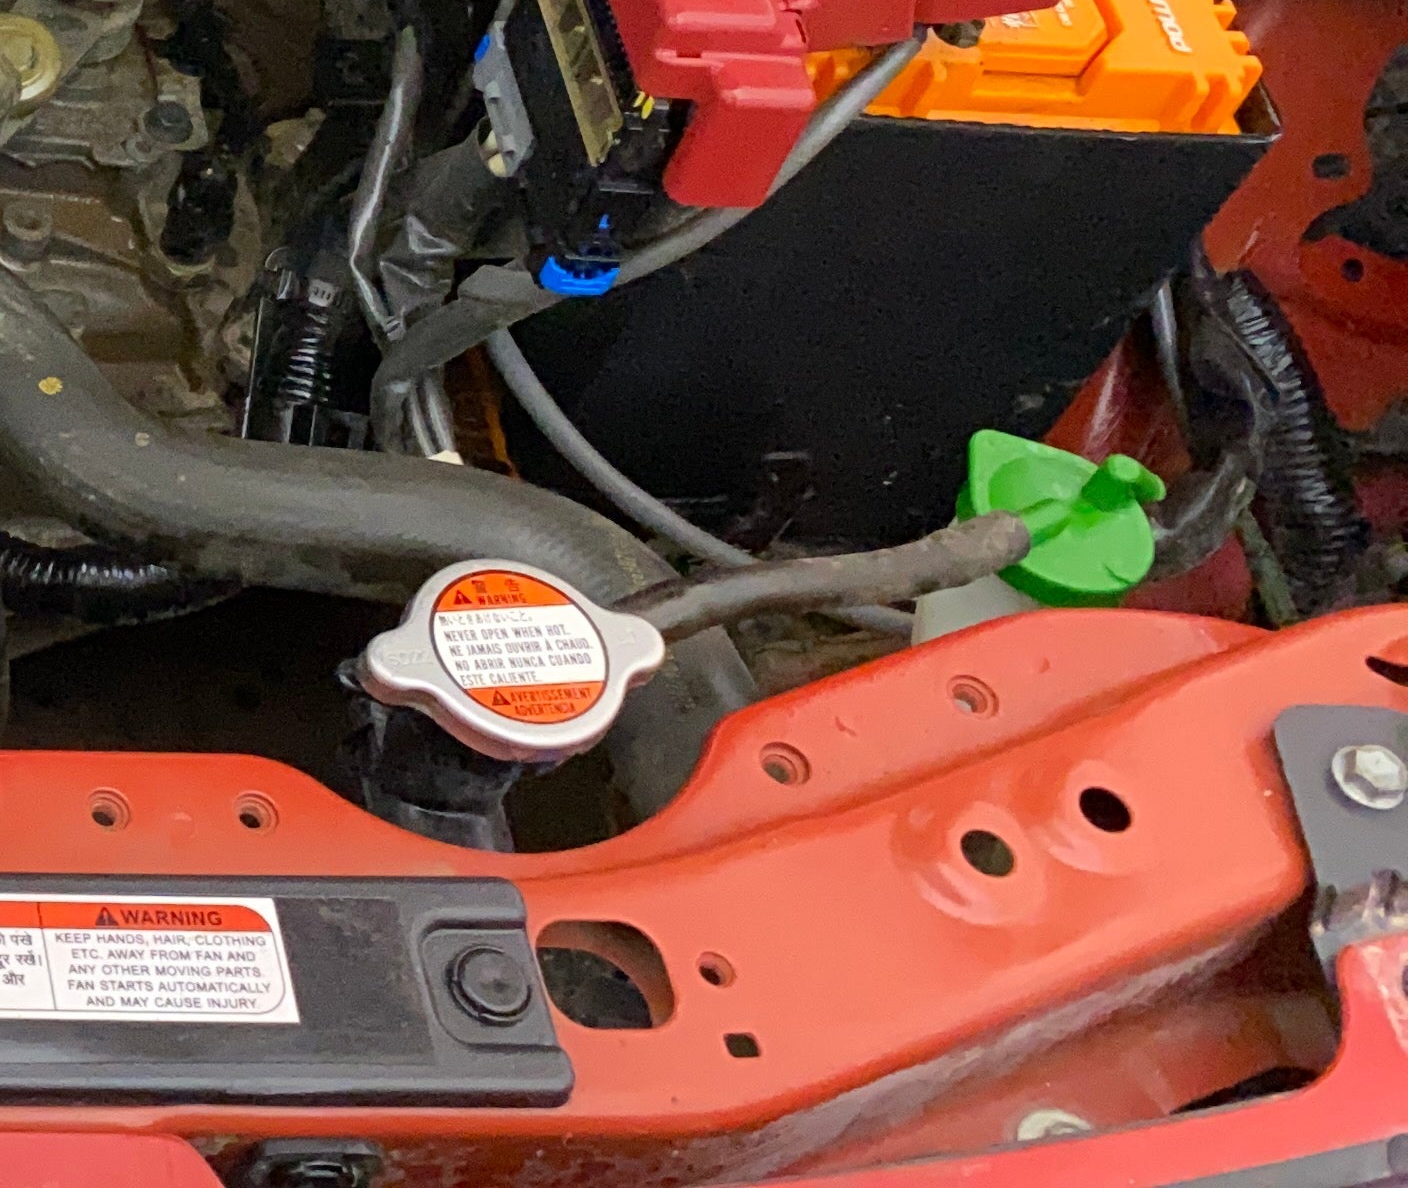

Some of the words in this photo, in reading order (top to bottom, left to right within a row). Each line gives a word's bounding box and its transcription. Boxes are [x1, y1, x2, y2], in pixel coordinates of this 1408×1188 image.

[478, 593, 528, 605] WARNING
[444, 629, 478, 642] NEVER
[481, 627, 508, 640] OPEN
[511, 625, 543, 638] WHEN
[449, 645, 464, 657] NE
[466, 643, 502, 656] JAMAIS
[505, 641, 542, 654] OUVRIR
[455, 660, 470, 671] NO
[475, 657, 506, 670] ABRIR
[508, 655, 546, 669] NUNCA
[548, 653, 592, 667] CUANDO
[460, 674, 486, 687] ESTE
[510, 687, 592, 703] AVERTISSEMENT
[120, 910, 223, 927] WARNING
[10, 930, 33, 947] पंखे
[55, 933, 91, 944] KEEP
[97, 934, 149, 946] HANDS,
[154, 935, 191, 947] HAIR,
[194, 935, 267, 946] CLOTHING
[71, 949, 103, 960] ETC.
[107, 950, 145, 960] AWAY
[150, 950, 191, 961] FROM
[195, 950, 223, 961] FAN
[227, 951, 256, 962] AND
[68, 964, 96, 975] ANY
[101, 964, 151, 976] OTHER
[155, 965, 211, 977] MOVING
[2, 972, 26, 986] और
[68, 980, 95, 991] FAN
[100, 980, 154, 992] STARTS
[158, 981, 271, 994] AUTOMATICALLY
[86, 996, 116, 1007] AND
[120, 997, 149, 1007] MAY
[152, 997, 201, 1008] CAUSE
